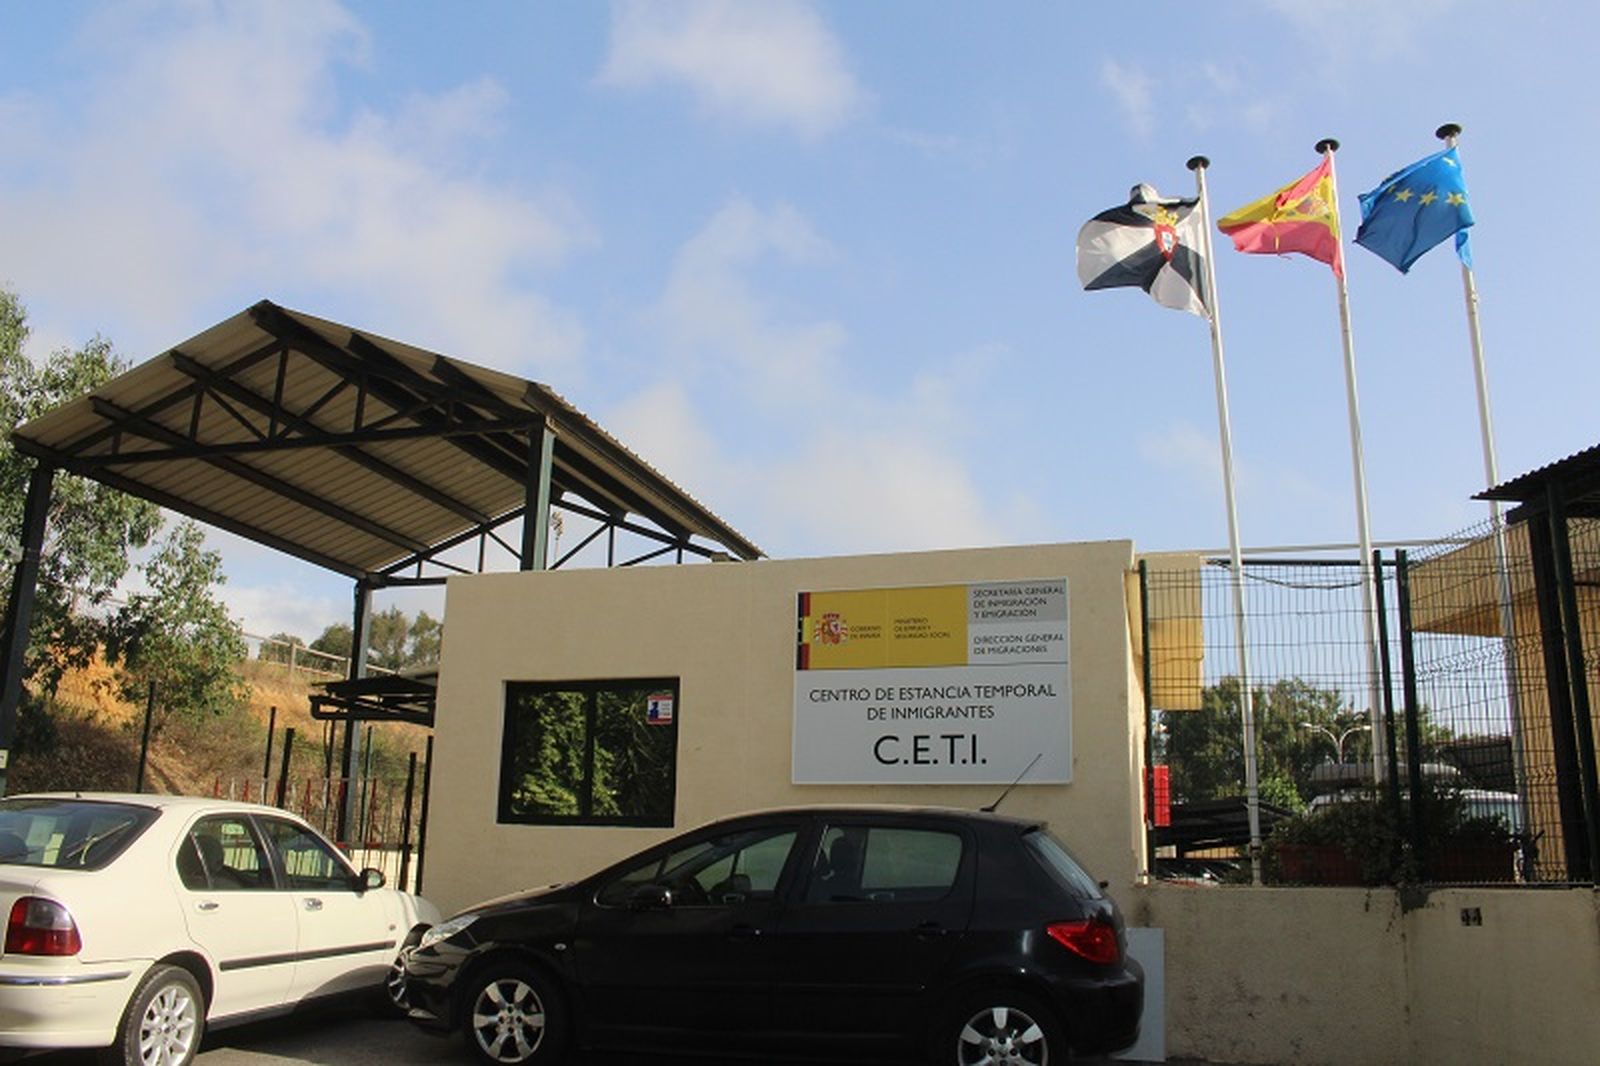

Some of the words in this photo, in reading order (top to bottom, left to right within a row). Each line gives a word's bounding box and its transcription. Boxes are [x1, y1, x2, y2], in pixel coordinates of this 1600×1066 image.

[973, 600, 985, 608] DE
[809, 688, 871, 702] CENTRO
[875, 687, 895, 701] DE
[899, 686, 972, 700] ESTANCIA
[974, 684, 1057, 698] TEMPORAL
[867, 707, 887, 720] DE
[891, 705, 995, 719] INMIGRANTES
[873, 734, 987, 765] C.E.T.I.
